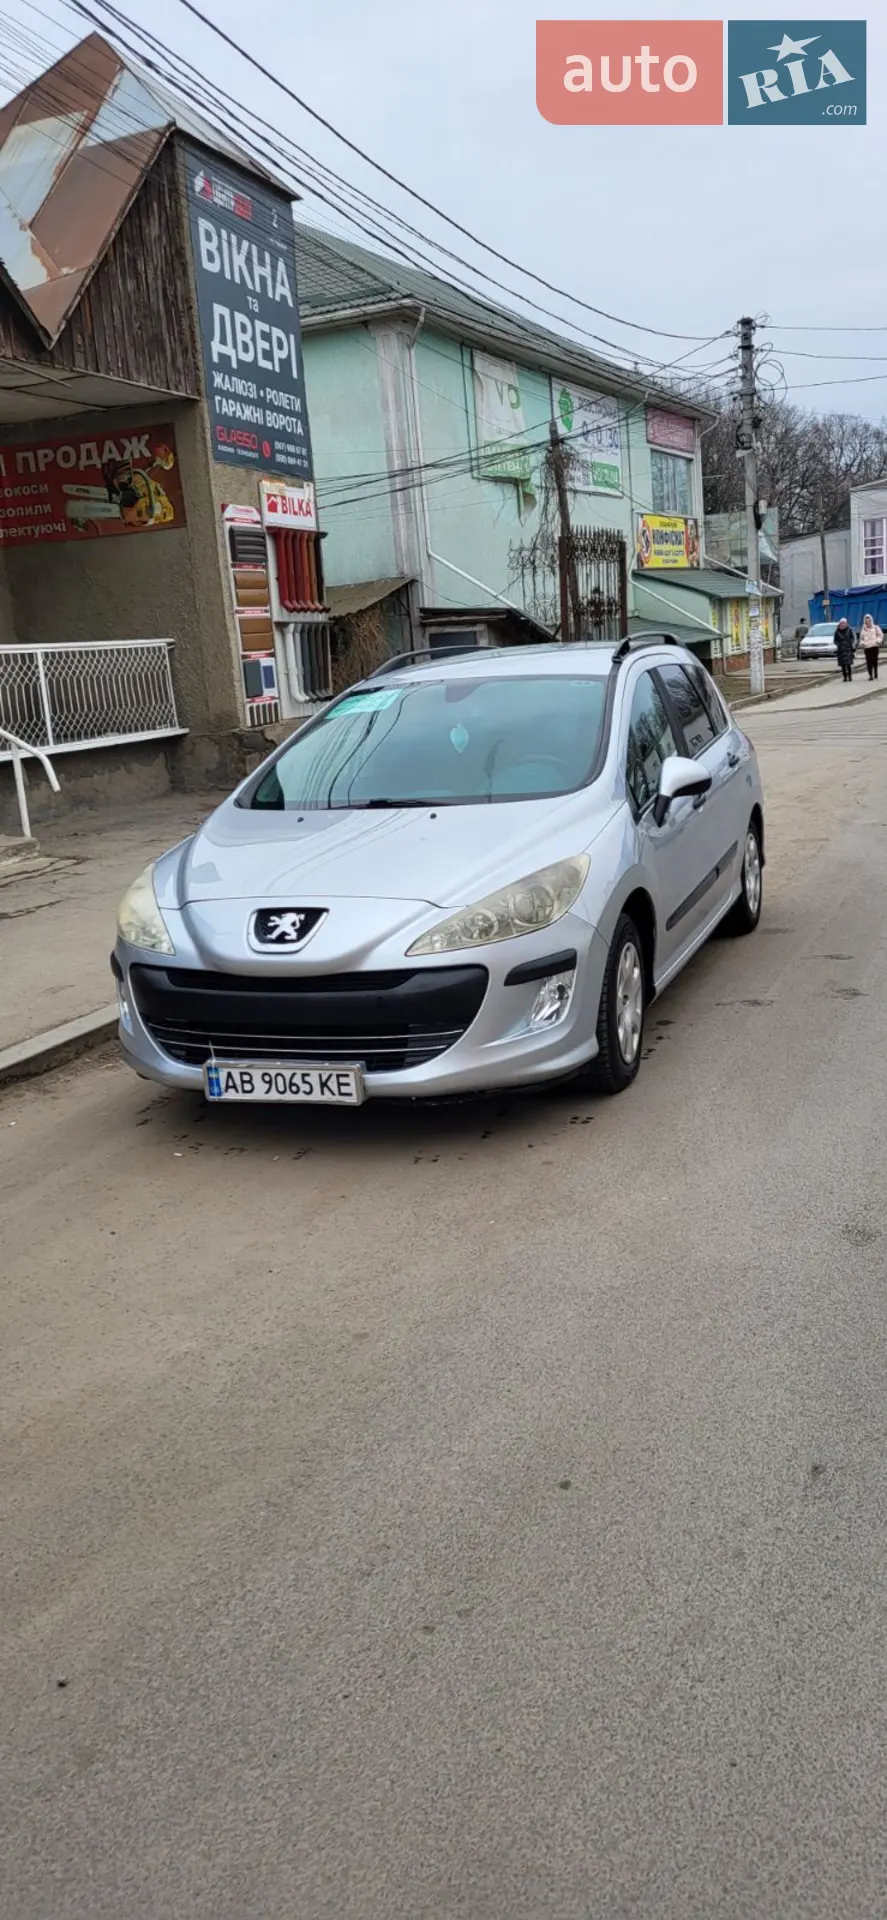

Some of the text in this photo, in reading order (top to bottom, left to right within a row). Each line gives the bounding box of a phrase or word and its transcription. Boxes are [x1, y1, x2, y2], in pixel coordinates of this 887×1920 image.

[198, 217, 294, 308] ВІКНА
[246, 296, 259, 313] та
[211, 302, 298, 379] ДВЕРІ
[212, 370, 301, 412] ЖАЛЮЗІ РОЛЕТИ
[214, 395, 304, 436] ГАРАЖНІ ВОРОТА
[16, 434, 152, 474] ПРОДАЖ
[216, 425, 258, 449] GLASSO
[281, 495, 313, 518] BILKA
[224, 1071, 255, 1094] AB
[261, 1072, 313, 1095] 9065
[318, 1073, 353, 1097] KE
